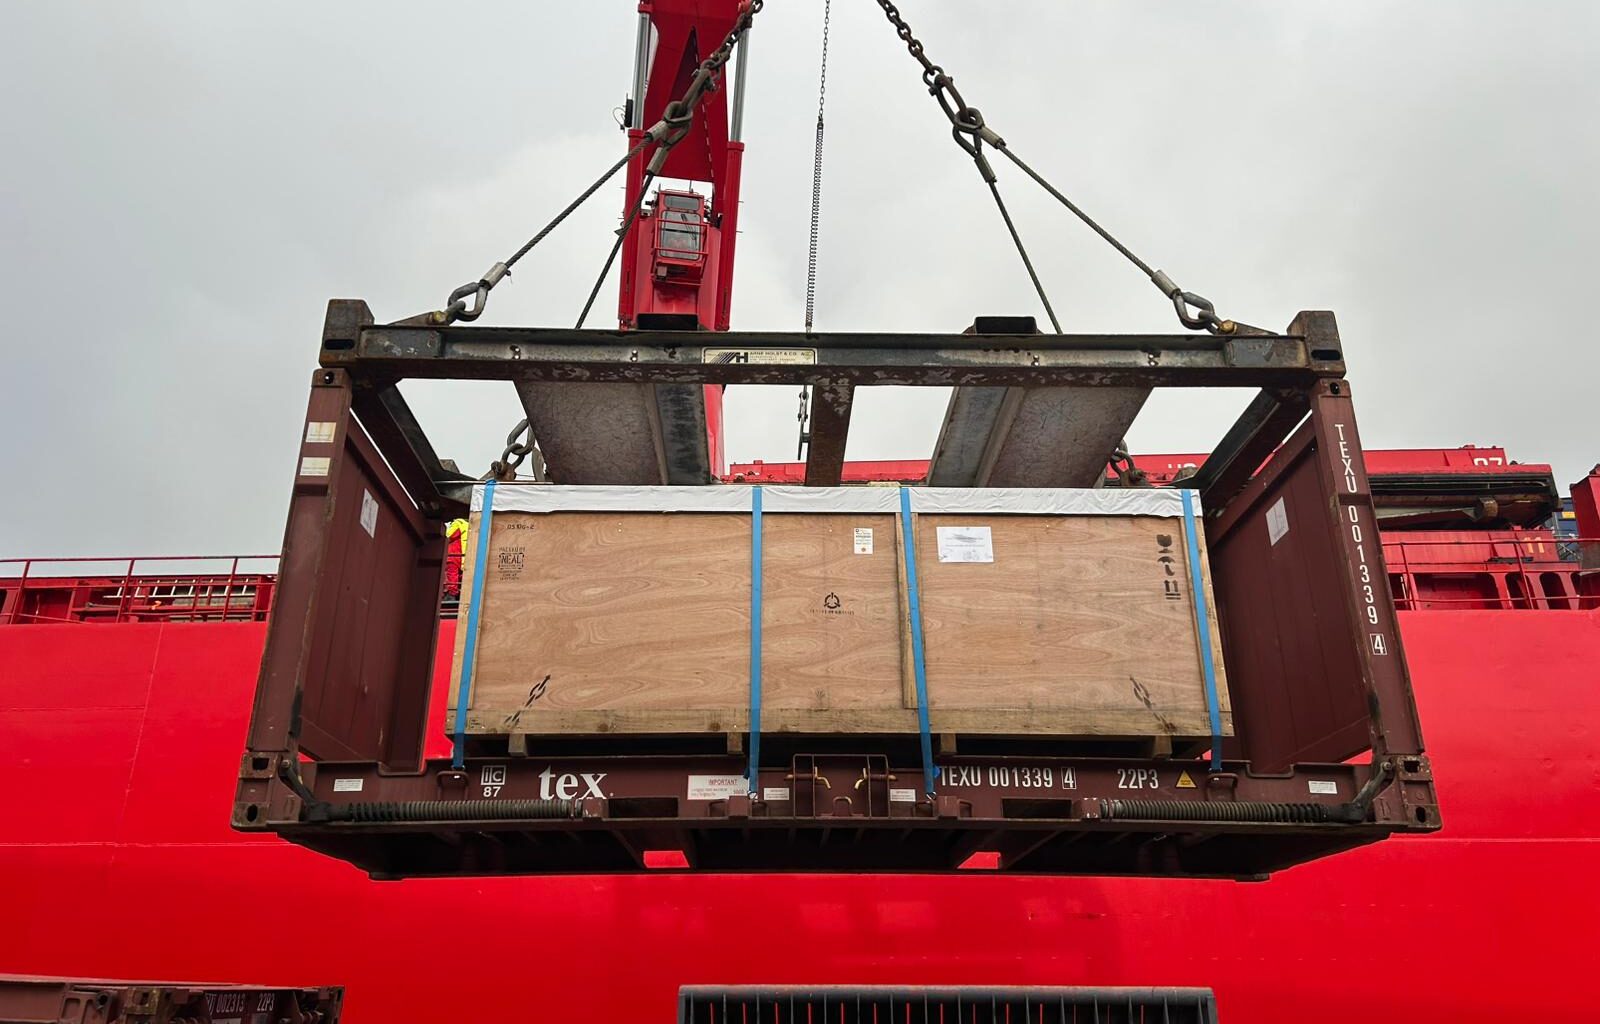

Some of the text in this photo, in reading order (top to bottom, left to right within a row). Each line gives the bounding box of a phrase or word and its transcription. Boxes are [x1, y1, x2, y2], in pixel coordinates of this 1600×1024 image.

[1335, 424, 1386, 655] TEXU 001339 4
[501, 555, 521, 564] NEAL
[939, 766, 1076, 789] TEXU 001339 4
[1117, 768, 1159, 789] 22P3
[483, 786, 501, 797] 87
